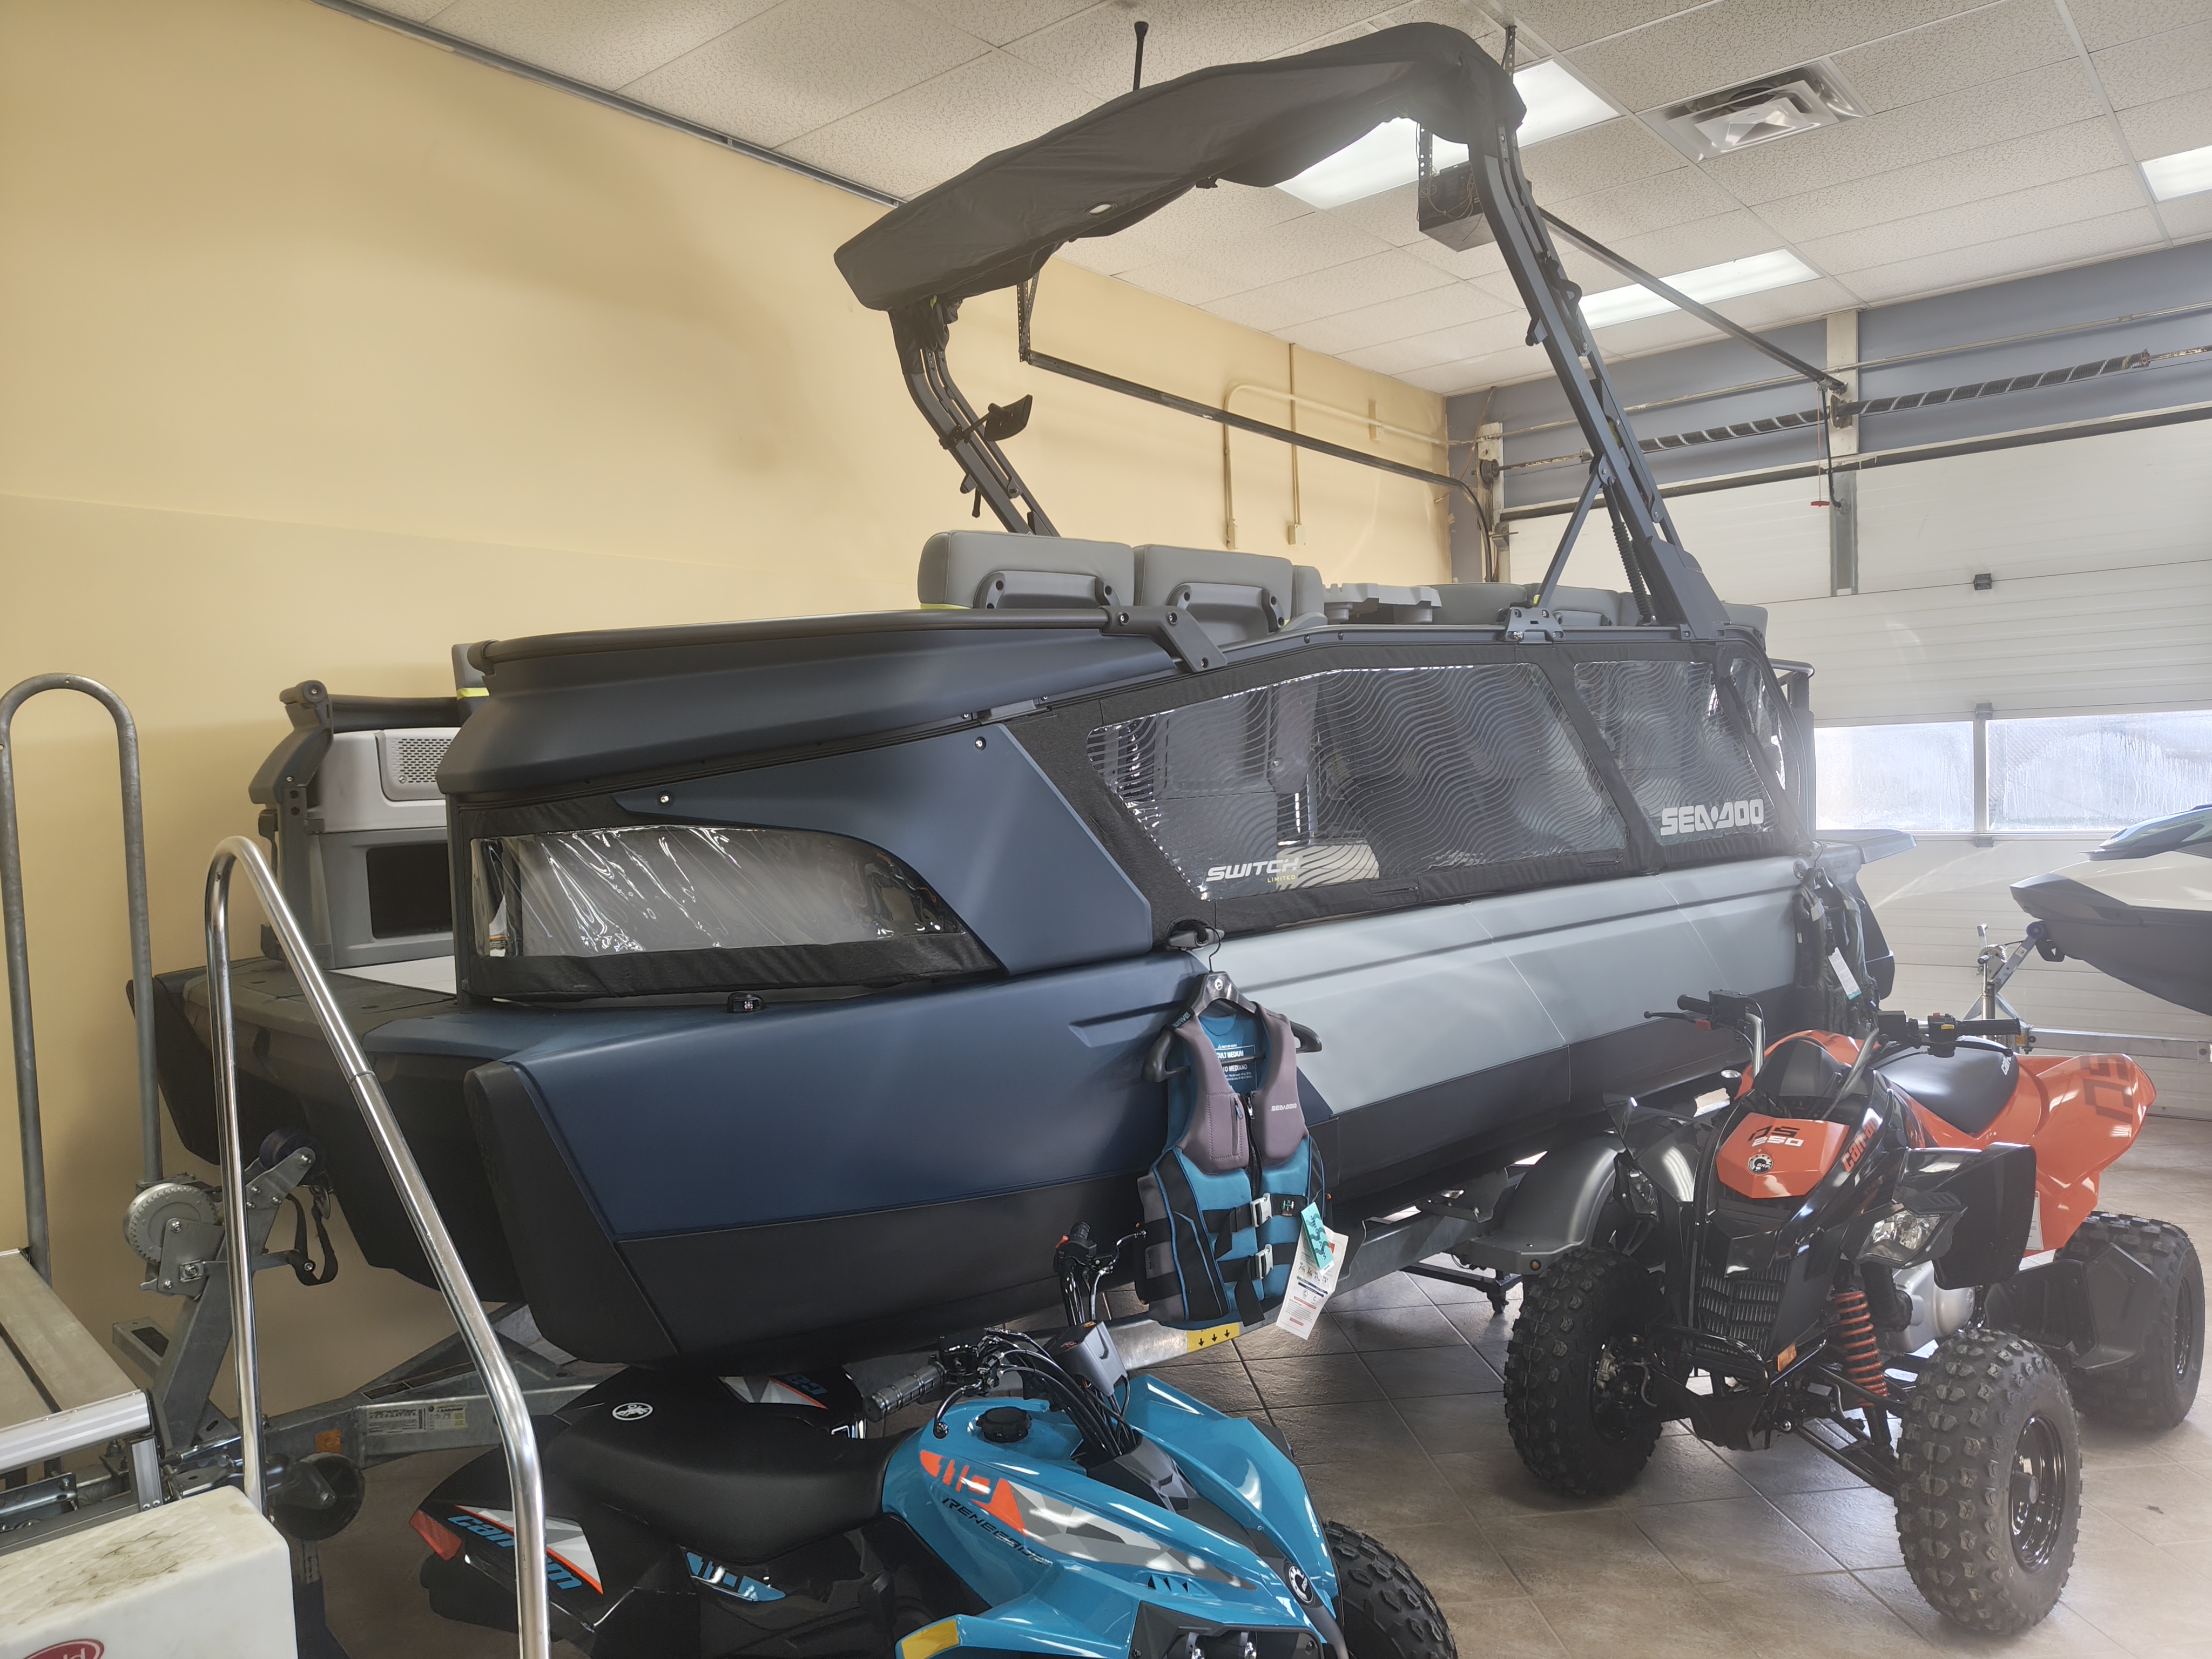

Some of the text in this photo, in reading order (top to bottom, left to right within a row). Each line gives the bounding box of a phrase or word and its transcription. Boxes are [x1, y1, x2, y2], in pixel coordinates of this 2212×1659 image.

[1205, 858, 1299, 882] SWITCH
[1267, 874, 1296, 883] LIMITED
[1172, 1011, 1191, 1027] WAVE
[1227, 1050, 1244, 1058] MEDIUM
[1229, 1063, 1248, 1072] MEDIANO
[1751, 1135, 1805, 1148] 250
[942, 1497, 1053, 1566] RENEGADE
